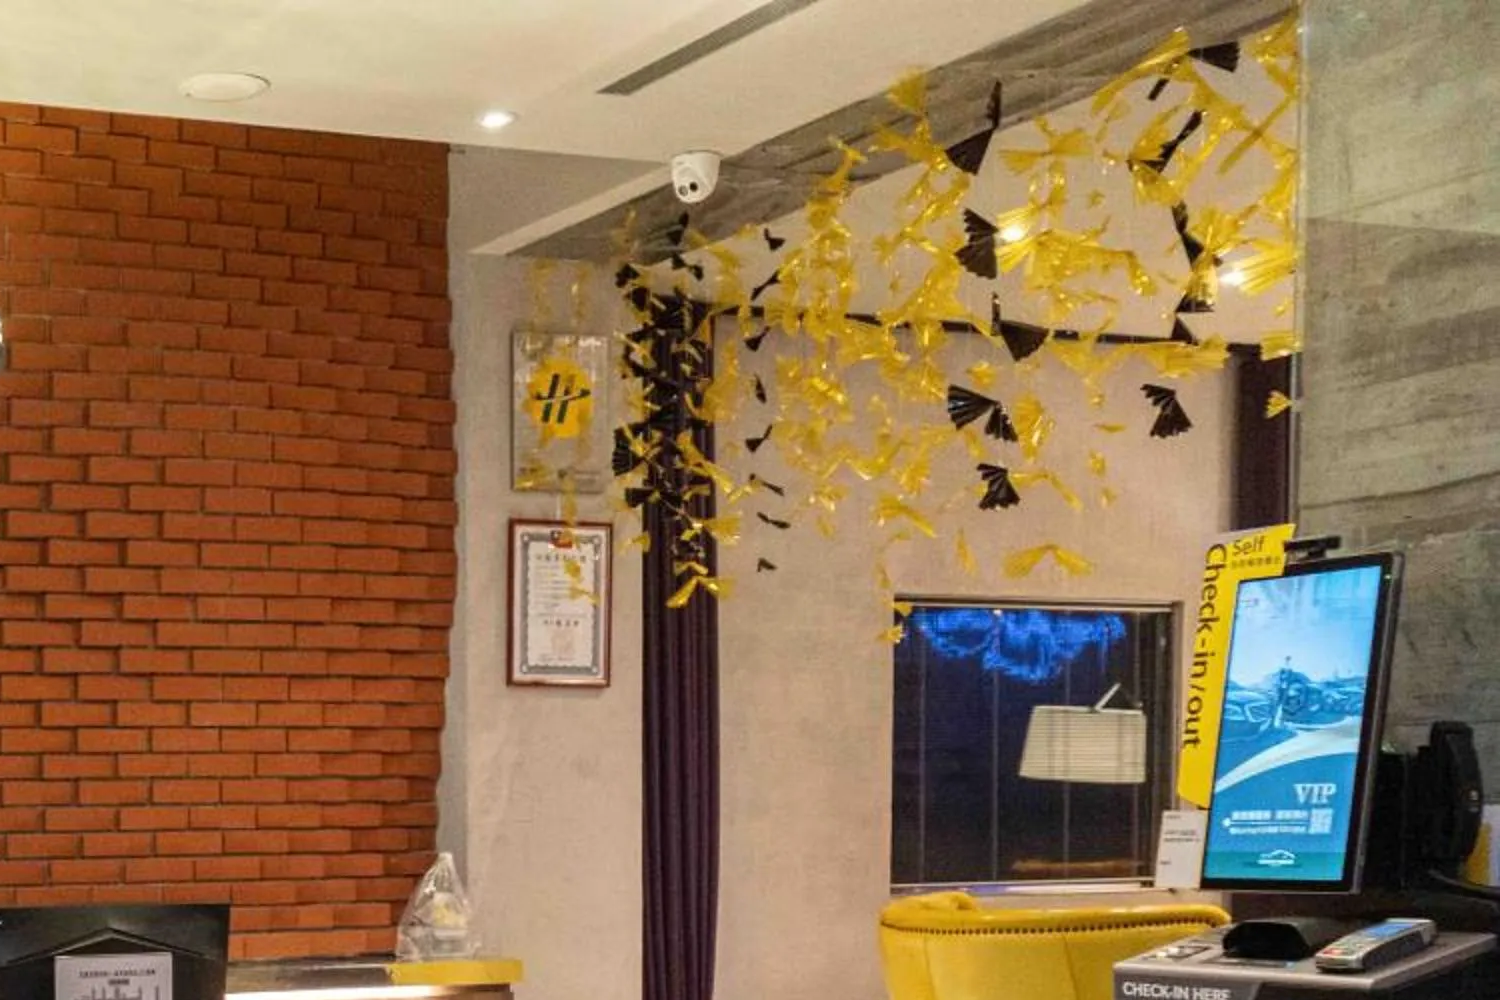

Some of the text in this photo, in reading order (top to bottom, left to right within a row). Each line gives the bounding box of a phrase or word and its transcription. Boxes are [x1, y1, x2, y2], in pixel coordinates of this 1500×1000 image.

[1232, 535, 1265, 556] Self
[1183, 543, 1227, 748] Check-in/out
[1293, 784, 1336, 805] VIP
[1122, 981, 1189, 999] CHECK-IN
